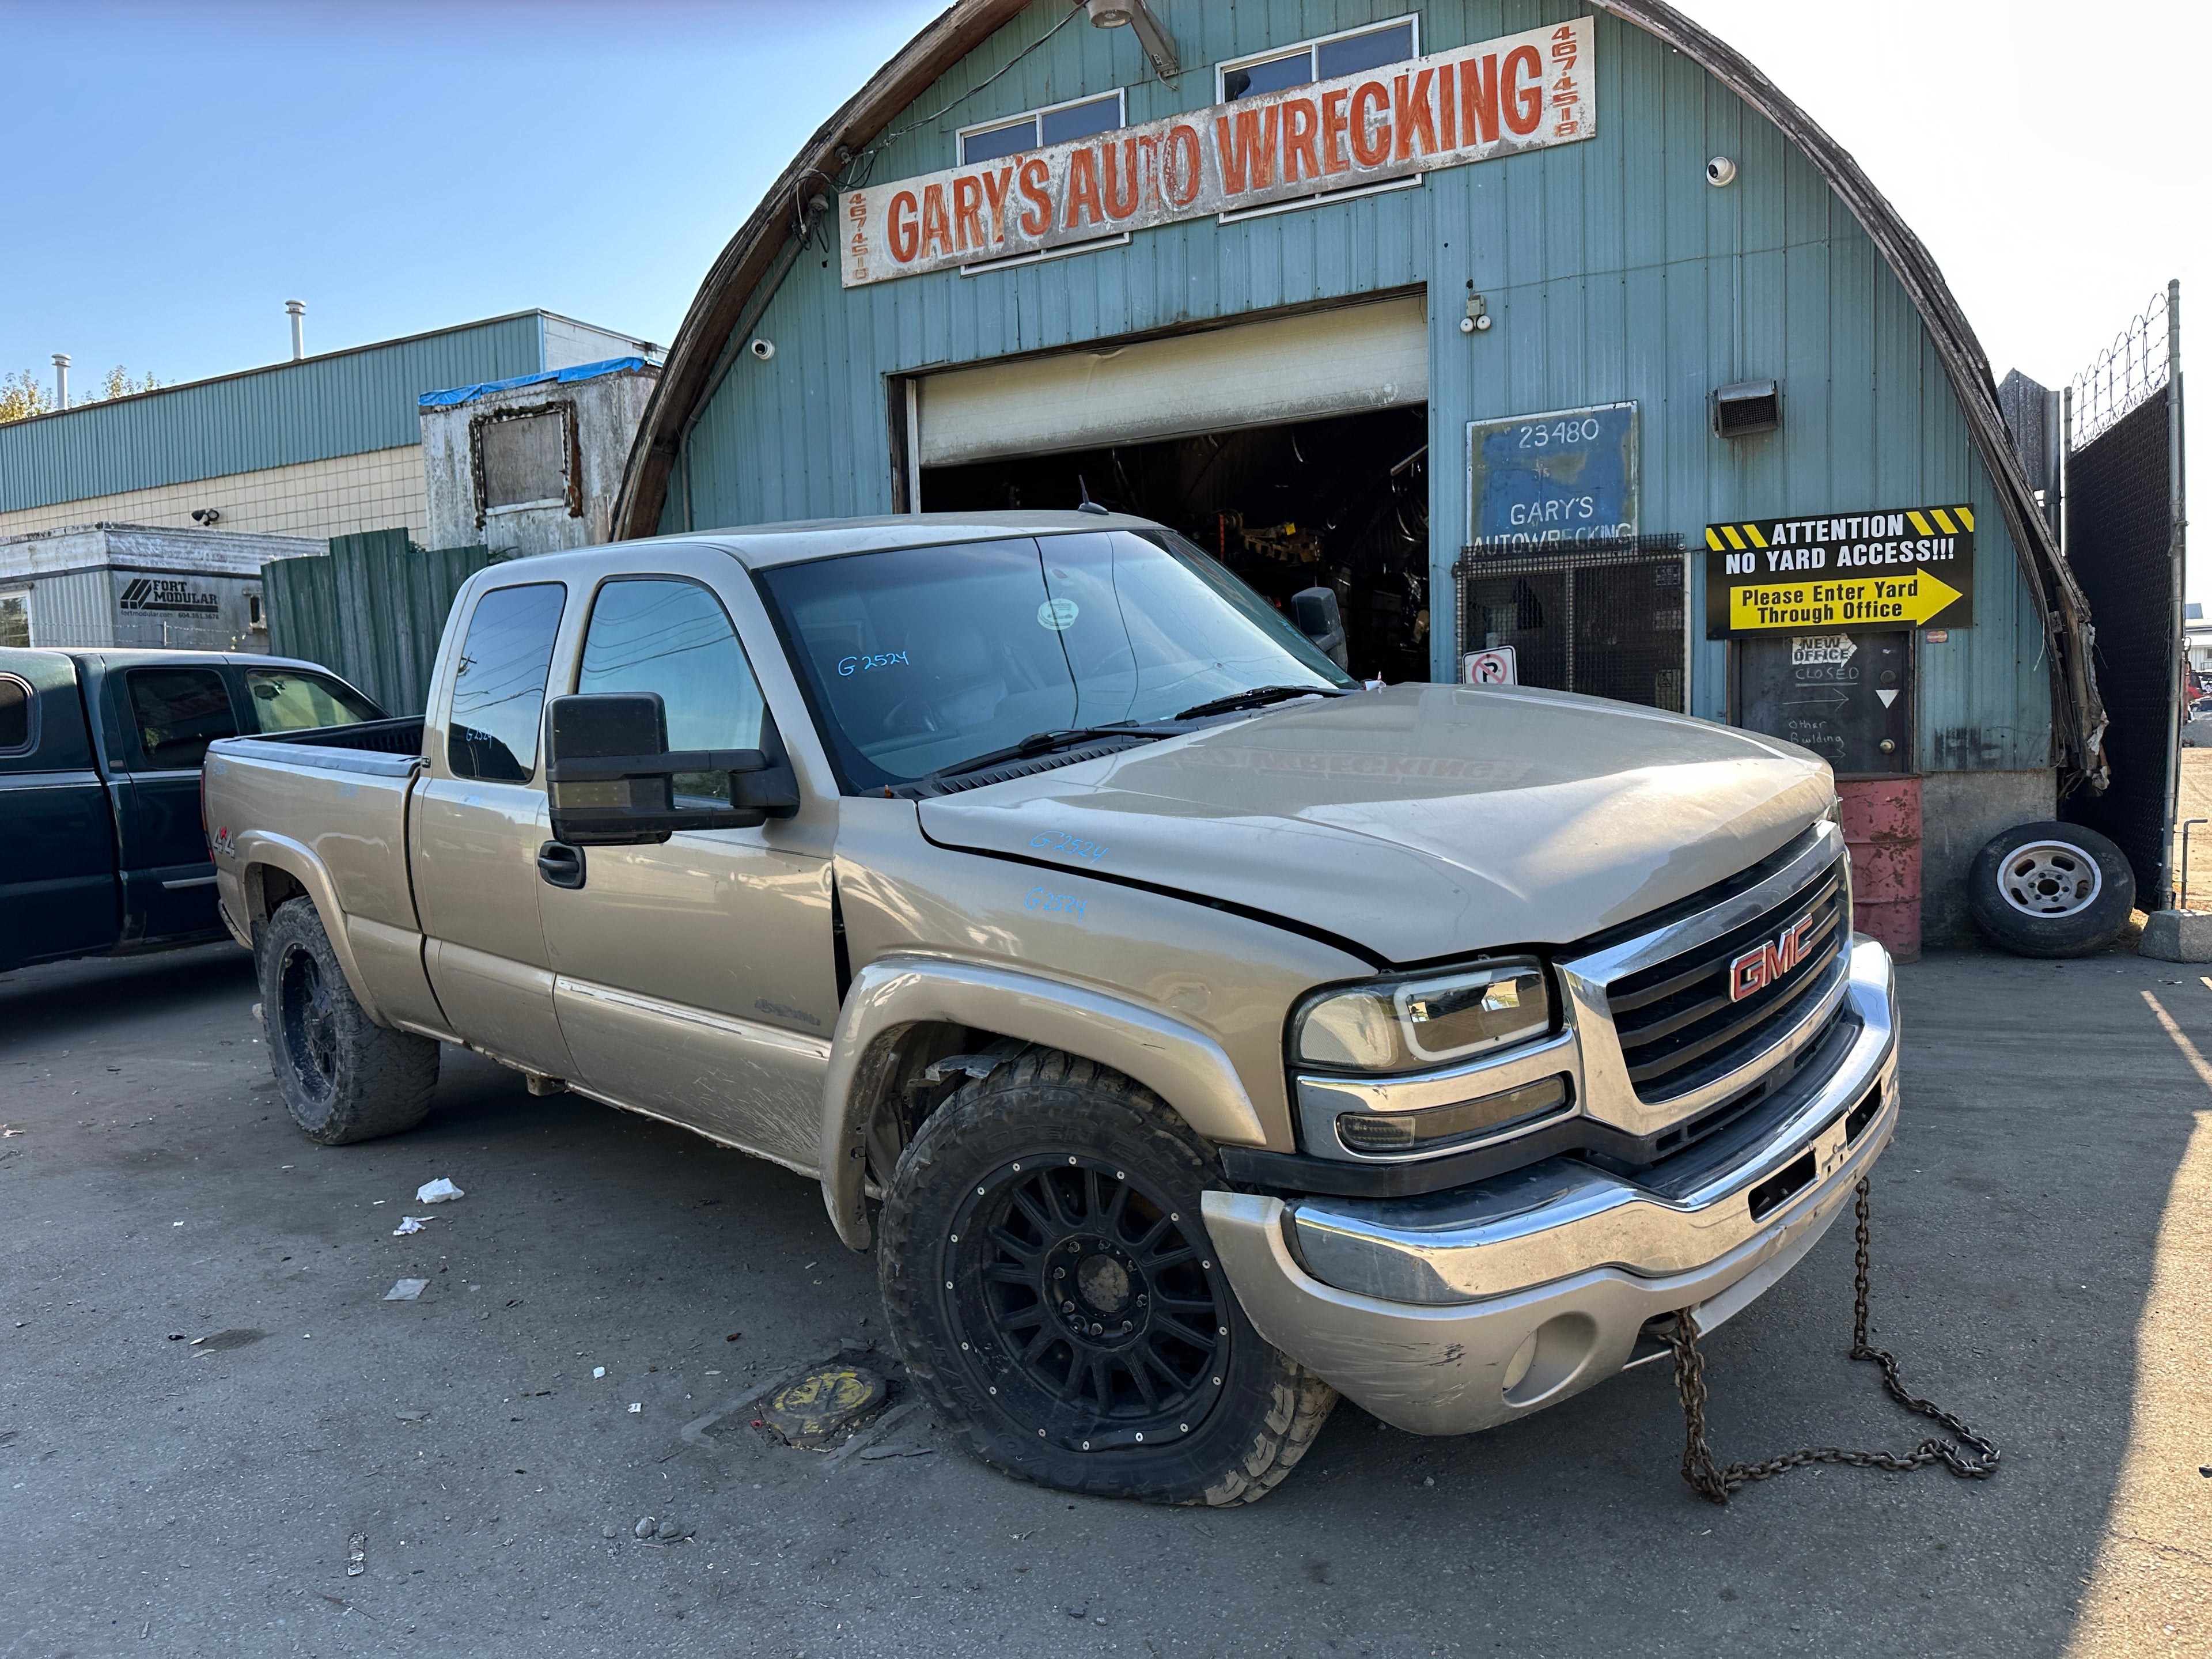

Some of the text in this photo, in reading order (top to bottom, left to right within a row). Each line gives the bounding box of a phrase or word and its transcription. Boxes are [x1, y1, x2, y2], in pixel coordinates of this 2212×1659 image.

[888, 46, 1542, 263] GARY'S AUTO WRECKING
[1519, 418, 1600, 448] 23480
[1510, 496, 1594, 525] GARY'S
[1771, 514, 1903, 546] ATTENTION
[1726, 537, 1955, 574] NO YARD ACCESS!!!
[153, 579, 187, 592] FORT
[154, 591, 218, 605] MODULAR
[1742, 579, 1918, 607] Please Enter Yard
[120, 609, 173, 618] fortmodular.com
[1757, 602, 1902, 624] Through Office
[1793, 649, 1849, 661] OFFICE
[1800, 638, 1841, 649] NEW
[1796, 666, 1859, 680] CLOSED
[1789, 719, 1827, 729] Other
[1024, 887, 1088, 924] G2524
[1730, 912, 1813, 1002] GMC
